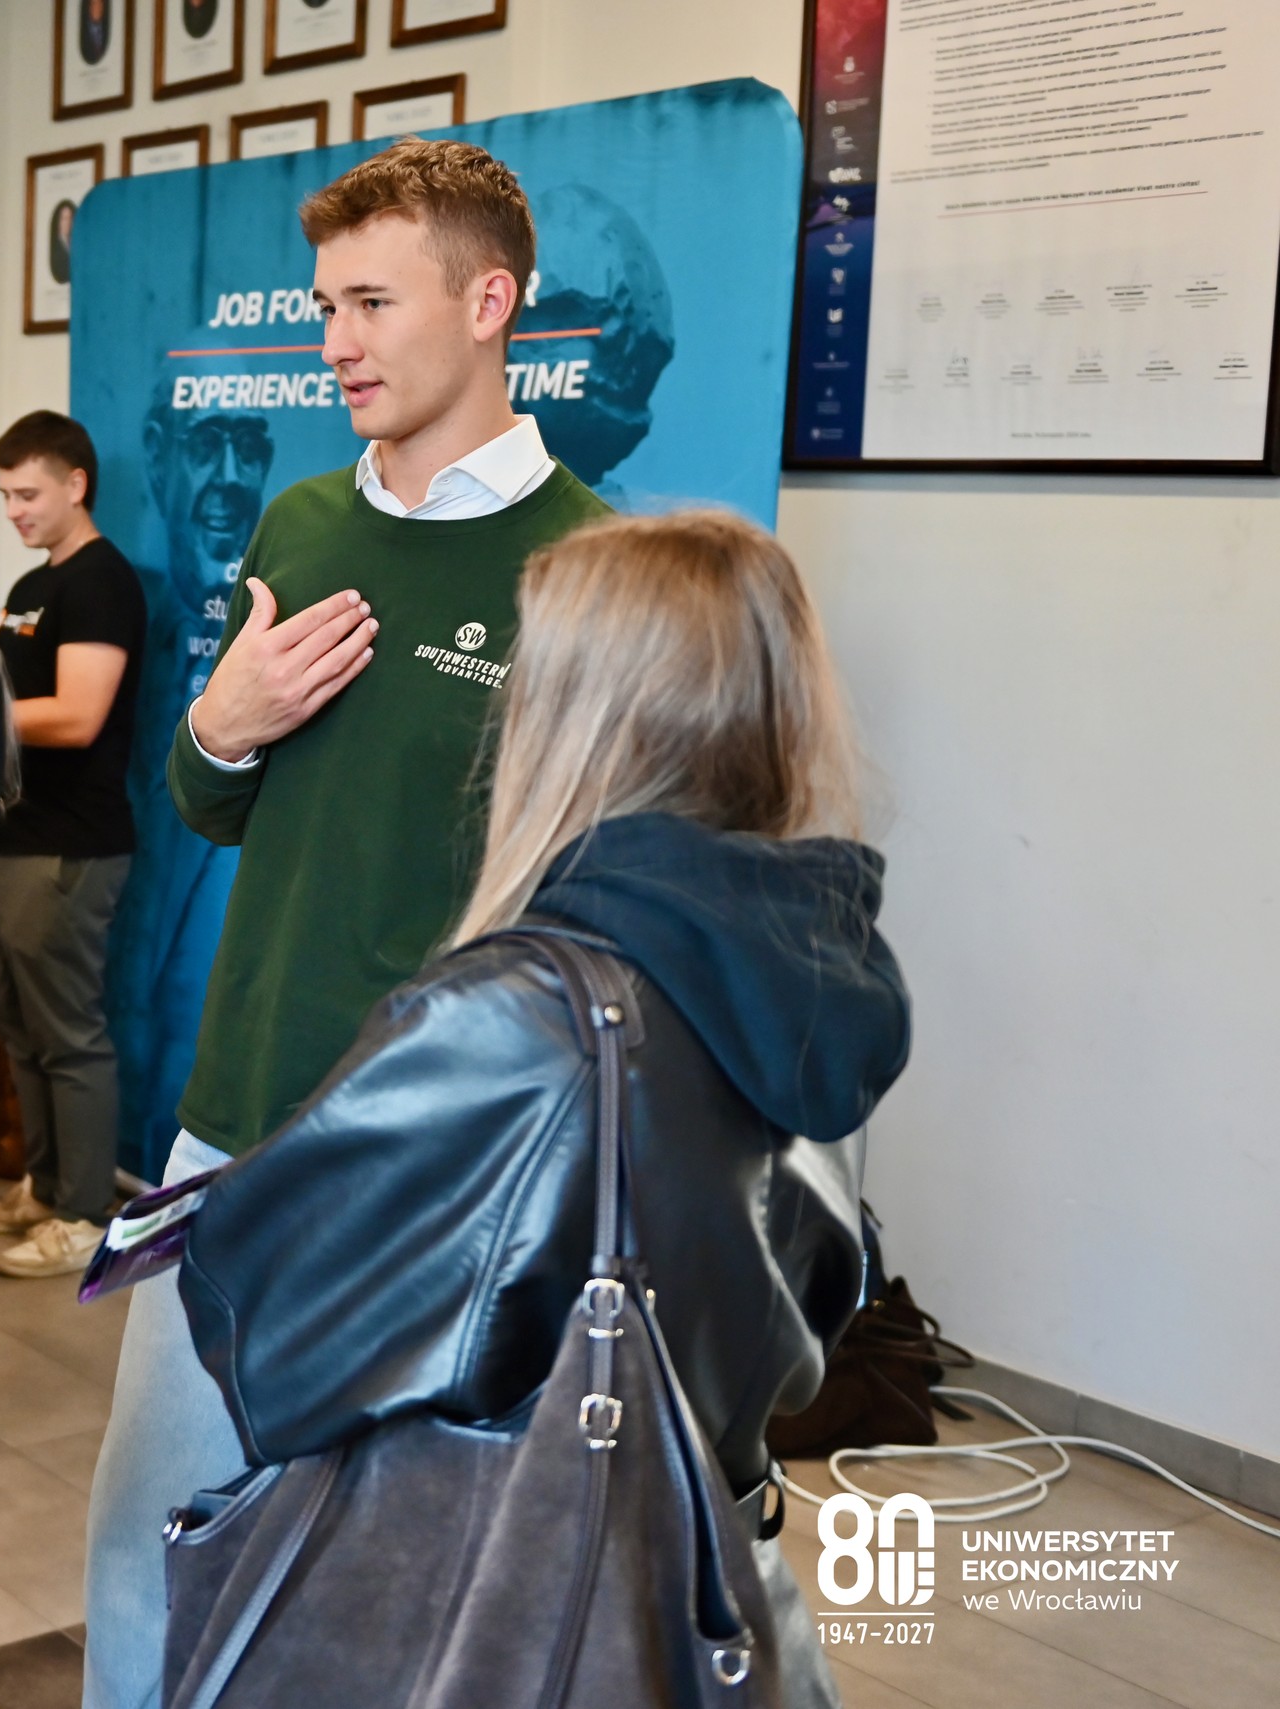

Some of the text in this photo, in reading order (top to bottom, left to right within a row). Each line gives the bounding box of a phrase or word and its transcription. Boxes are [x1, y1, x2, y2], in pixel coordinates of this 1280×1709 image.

[208, 287, 322, 328] JOB FOR
[172, 372, 336, 409] EXPERIENCE
[457, 625, 487, 647] SW
[414, 644, 512, 679] SOUTHWESTERN
